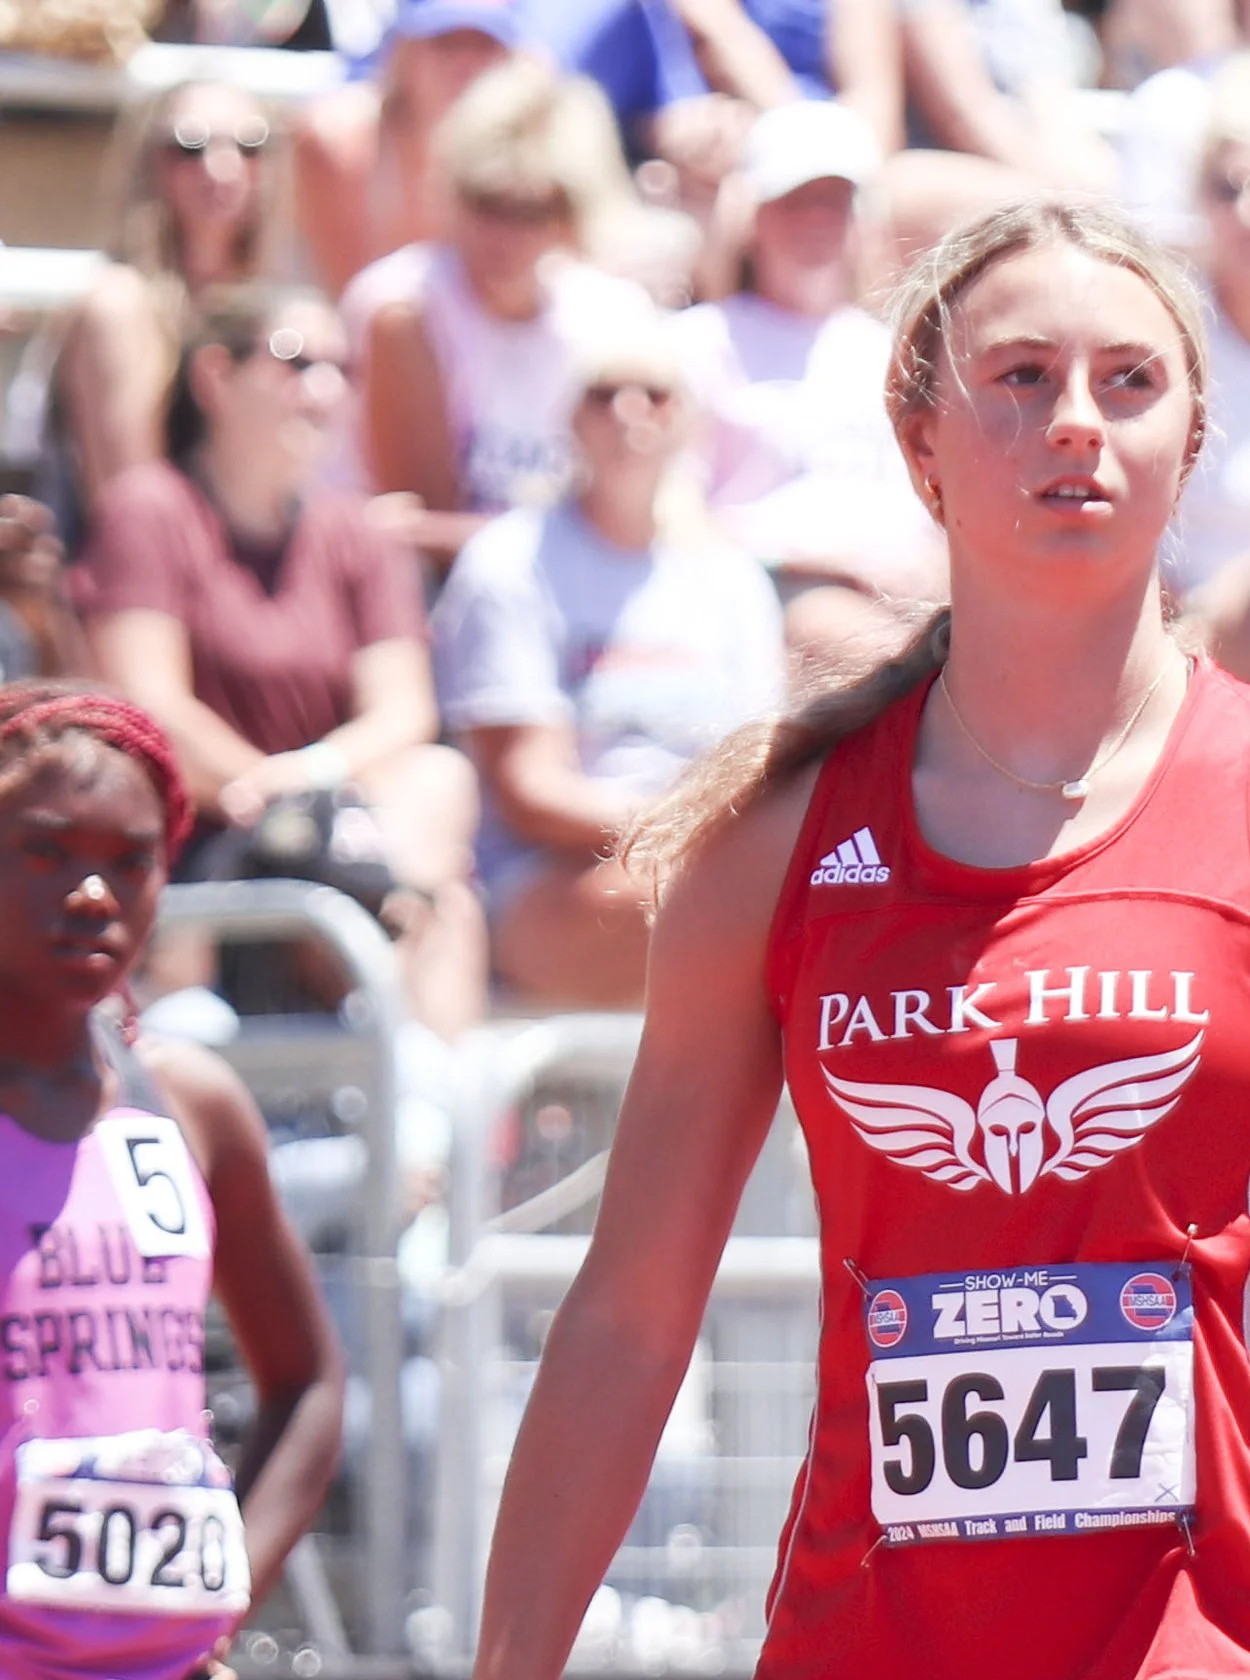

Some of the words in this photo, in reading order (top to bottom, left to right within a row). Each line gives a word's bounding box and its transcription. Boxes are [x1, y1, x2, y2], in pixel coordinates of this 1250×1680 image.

[810, 863, 891, 886] adidas
[816, 981, 1003, 1051] PARK
[1023, 964, 1210, 1025] HILL
[125, 1137, 188, 1235] 5
[931, 1283, 1088, 1339] ZERO
[965, 1270, 1049, 1291] SHOW-ME
[876, 1365, 1166, 1496] 5647
[35, 1499, 226, 1591] 5020
[887, 1525, 915, 1542] 2024
[964, 1517, 998, 1536] Track
[1004, 1515, 1028, 1533] and
[1034, 1512, 1067, 1531] Field
[1074, 1509, 1177, 1528] Championships
